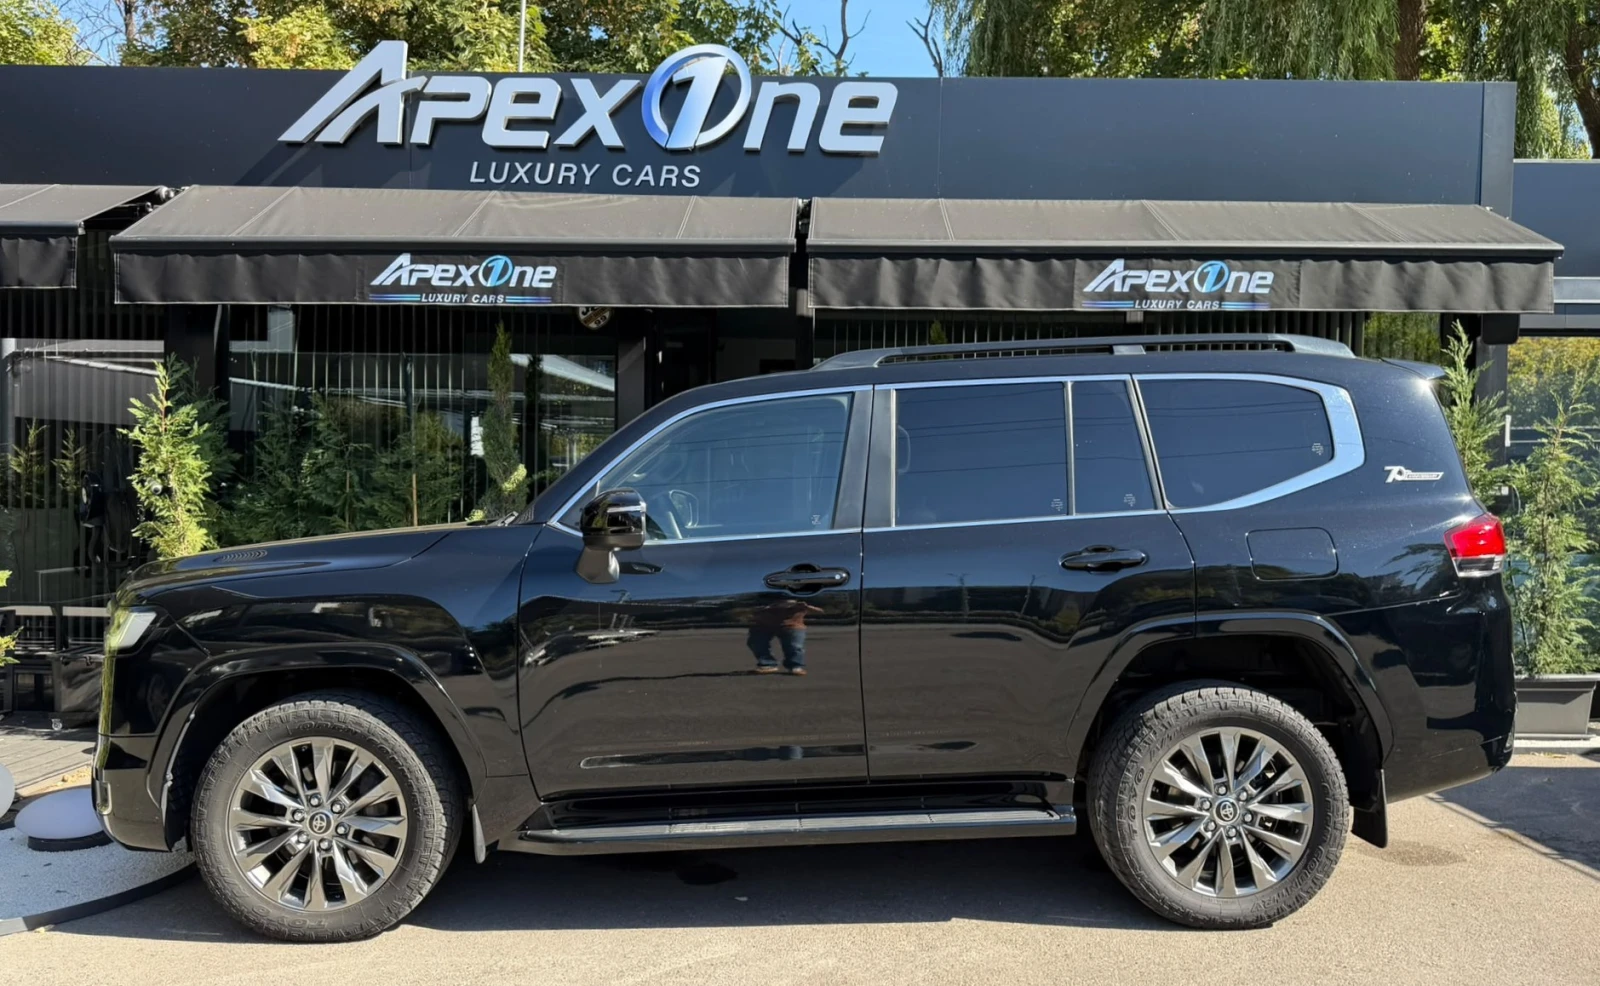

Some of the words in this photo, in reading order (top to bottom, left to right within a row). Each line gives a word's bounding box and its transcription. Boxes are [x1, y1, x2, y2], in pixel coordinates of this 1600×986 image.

[469, 160, 600, 187] LUXURY
[611, 163, 702, 189] CARS
[420, 293, 469, 304] LUXURY
[471, 294, 505, 304] CARS
[1134, 299, 1183, 310] LUXURY
[1186, 300, 1221, 310] CARS
